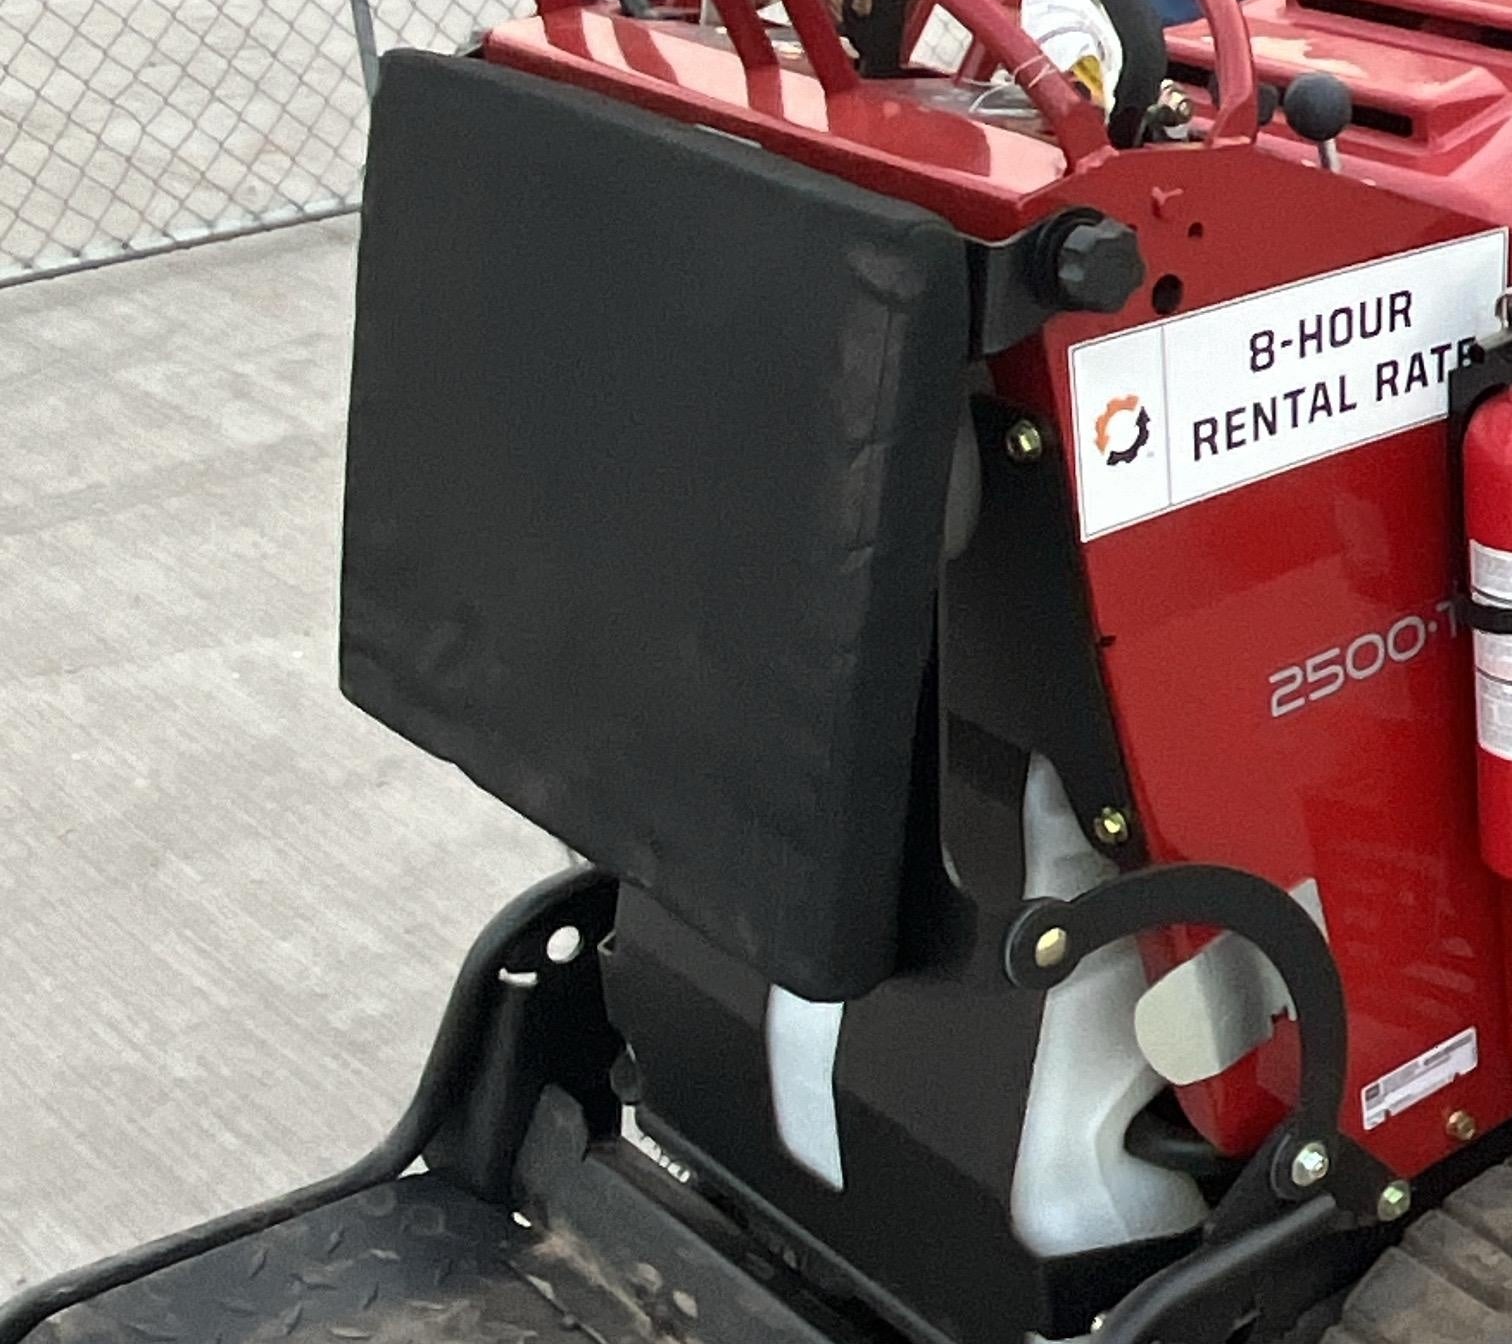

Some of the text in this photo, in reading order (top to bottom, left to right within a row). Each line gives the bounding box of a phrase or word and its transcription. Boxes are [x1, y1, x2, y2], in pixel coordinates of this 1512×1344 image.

[1249, 289, 1413, 374] 8-HOUR
[1193, 336, 1476, 461] RENTAL RATE
